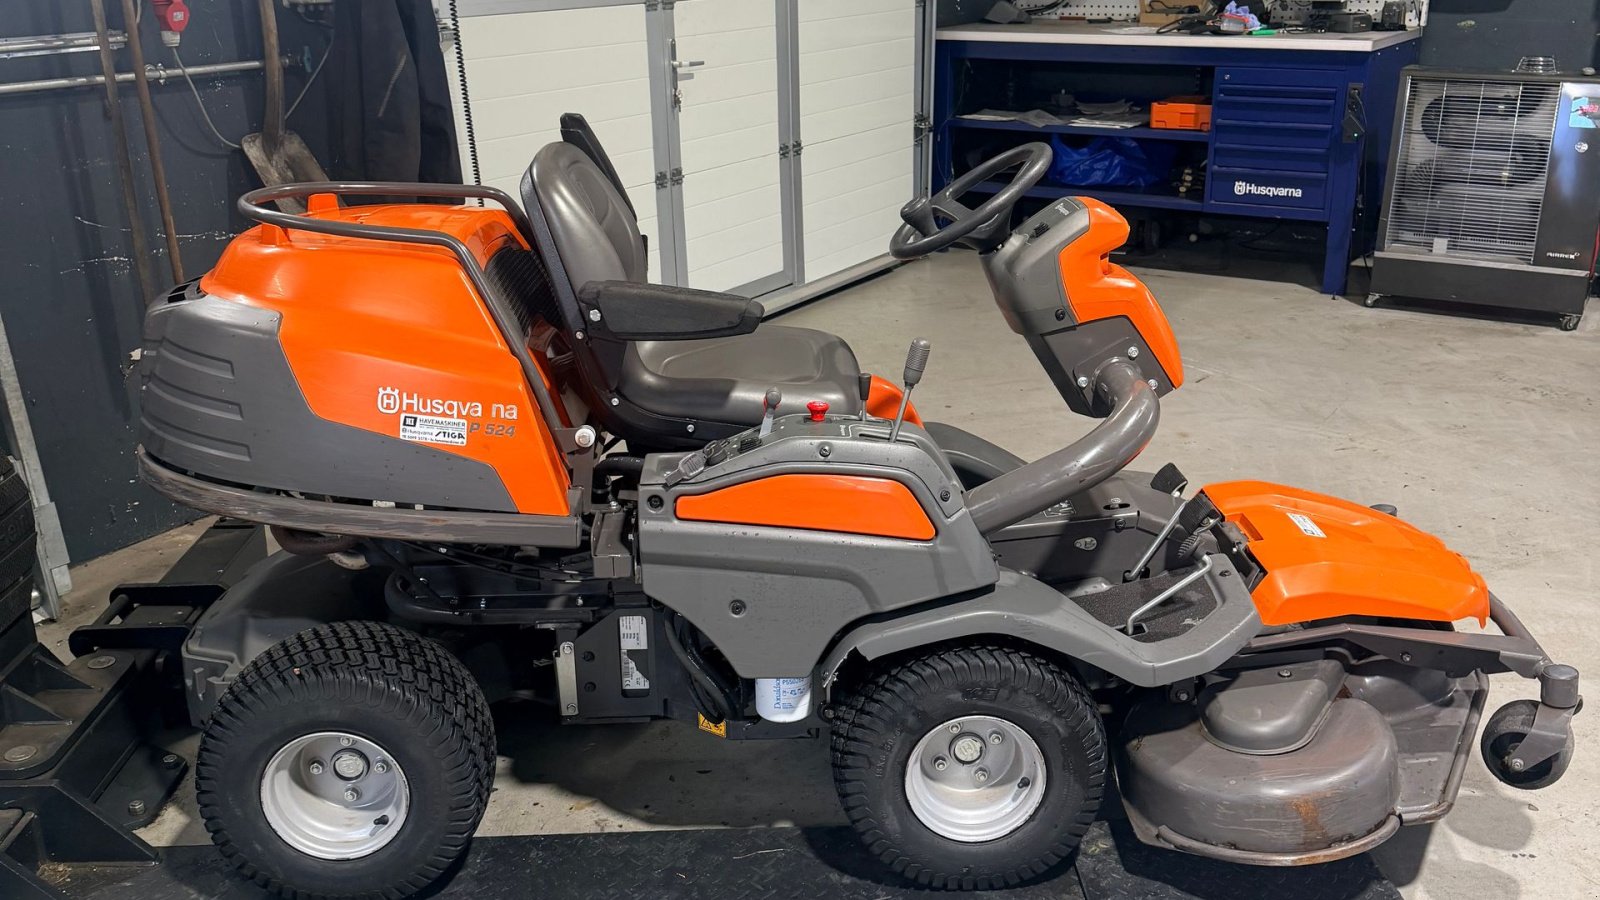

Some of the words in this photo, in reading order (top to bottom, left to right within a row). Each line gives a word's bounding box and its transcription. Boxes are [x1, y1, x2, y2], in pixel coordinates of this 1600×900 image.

[1246, 183, 1302, 197] Husqvarna
[419, 417, 466, 427] HAVEMASKINER
[469, 422, 480, 433] P
[484, 423, 516, 437] 524
[773, 678, 781, 709] Donaldso
